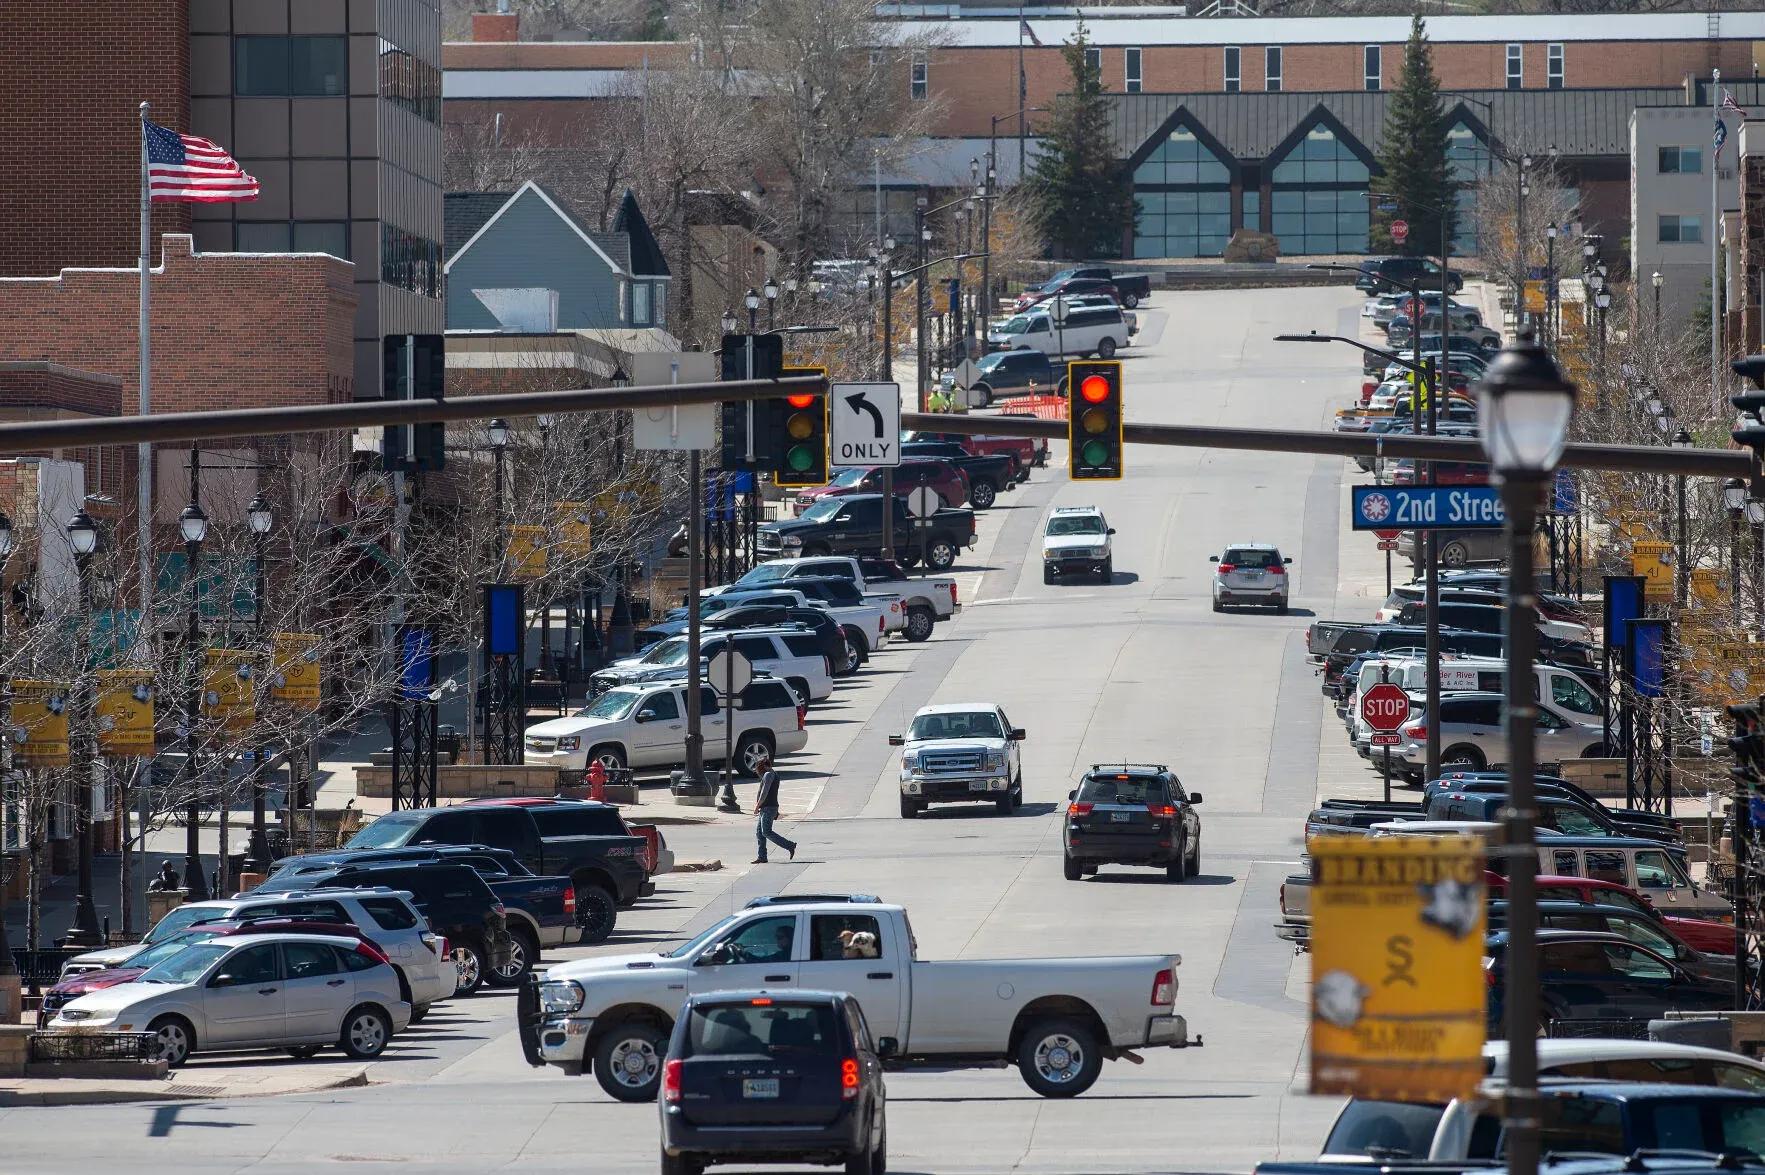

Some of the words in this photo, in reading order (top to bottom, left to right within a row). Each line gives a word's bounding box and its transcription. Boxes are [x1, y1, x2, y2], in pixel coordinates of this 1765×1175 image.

[1406, 304, 1424, 312] STP
[842, 443, 890, 458] ONLY
[1396, 492, 1436, 522] 2nd
[1448, 490, 1506, 522] Stree
[1366, 699, 1406, 716] STOP
